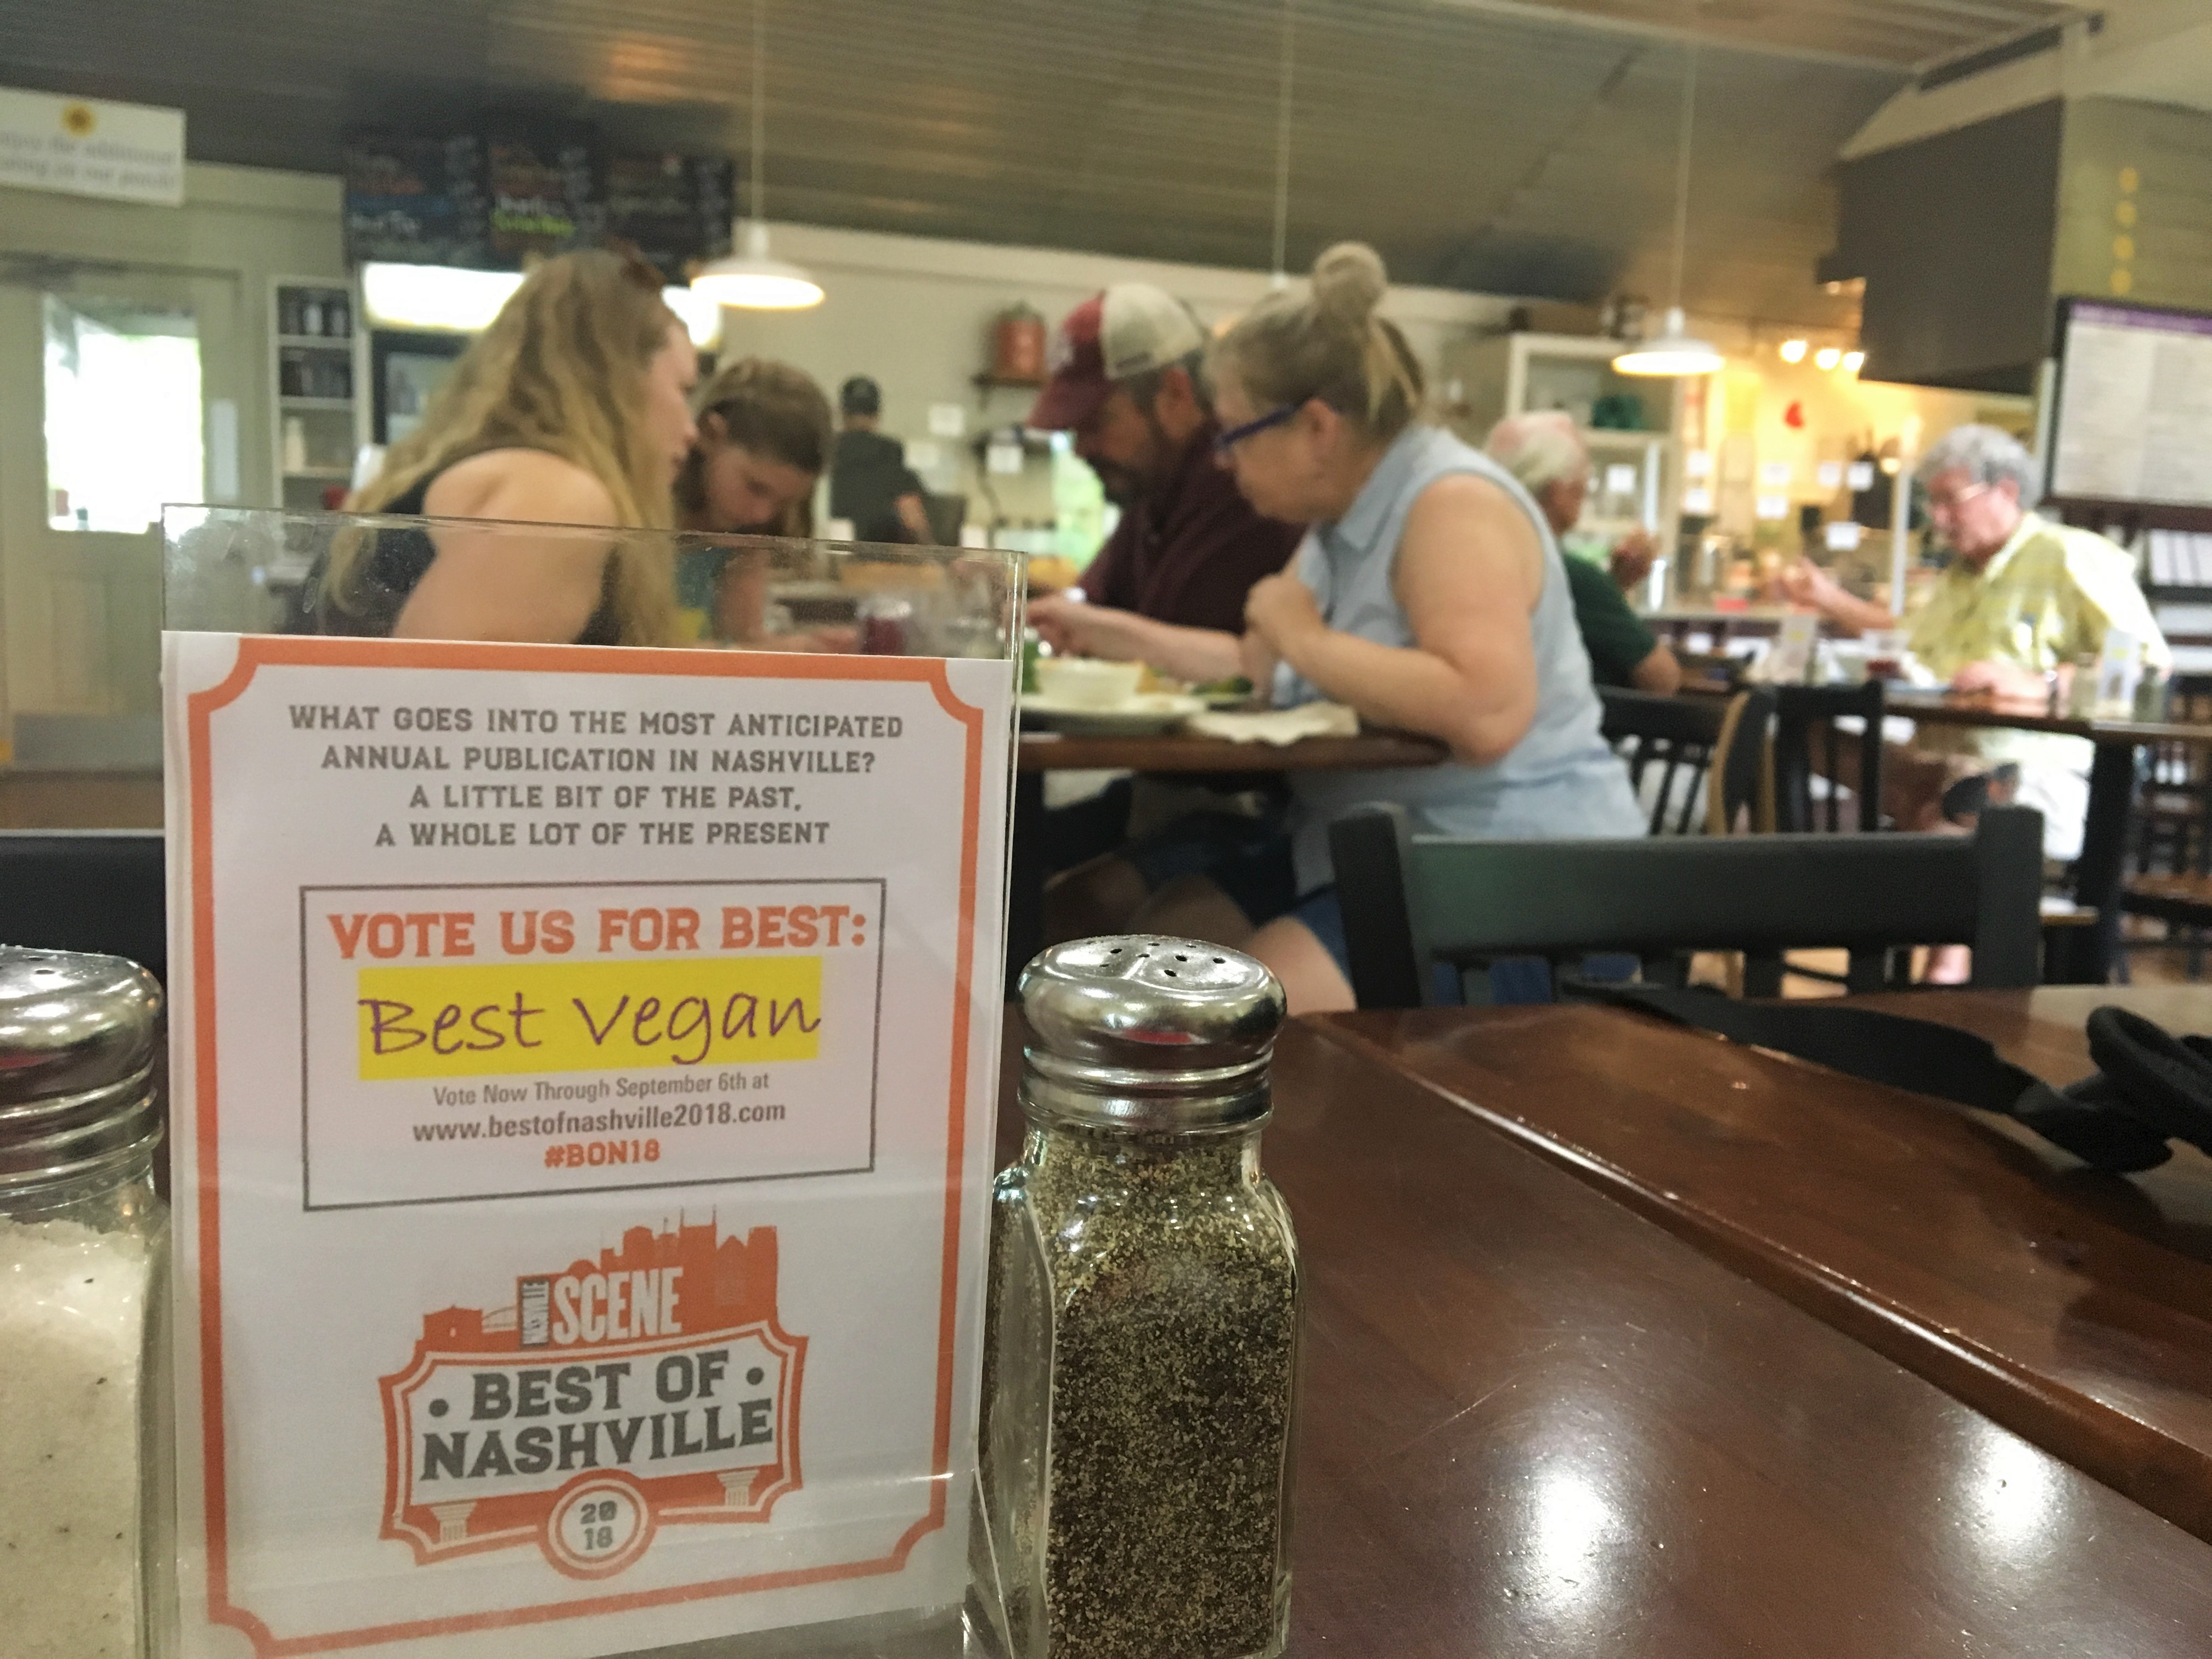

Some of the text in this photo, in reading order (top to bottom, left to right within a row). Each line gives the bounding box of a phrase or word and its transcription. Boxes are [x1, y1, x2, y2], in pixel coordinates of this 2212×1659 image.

[289, 705, 902, 738] WHAT GOES INTO THE MOST ANTICIPATED
[321, 745, 875, 773] ANNUAL PUBLICATION IN NASHVILLE?
[409, 785, 801, 811] A LITTLE BIT OF THE PAST,
[375, 822, 830, 847] A WHOLE LOT OF THE PRESENT
[327, 905, 867, 960] VOTE US FOR BEST:
[358, 991, 544, 1056] Best
[433, 1072, 769, 1106] Vote Now Through September 6th at
[413, 1101, 786, 1141] www.bestofnashville2018.com
[544, 1138, 661, 1169] #BON18
[552, 1267, 684, 1345] SCENE
[470, 1348, 730, 1421] BEST OF
[420, 1398, 774, 1481] NASHVILLE
[580, 1500, 618, 1524] 20
[584, 1526, 613, 1550] 18
